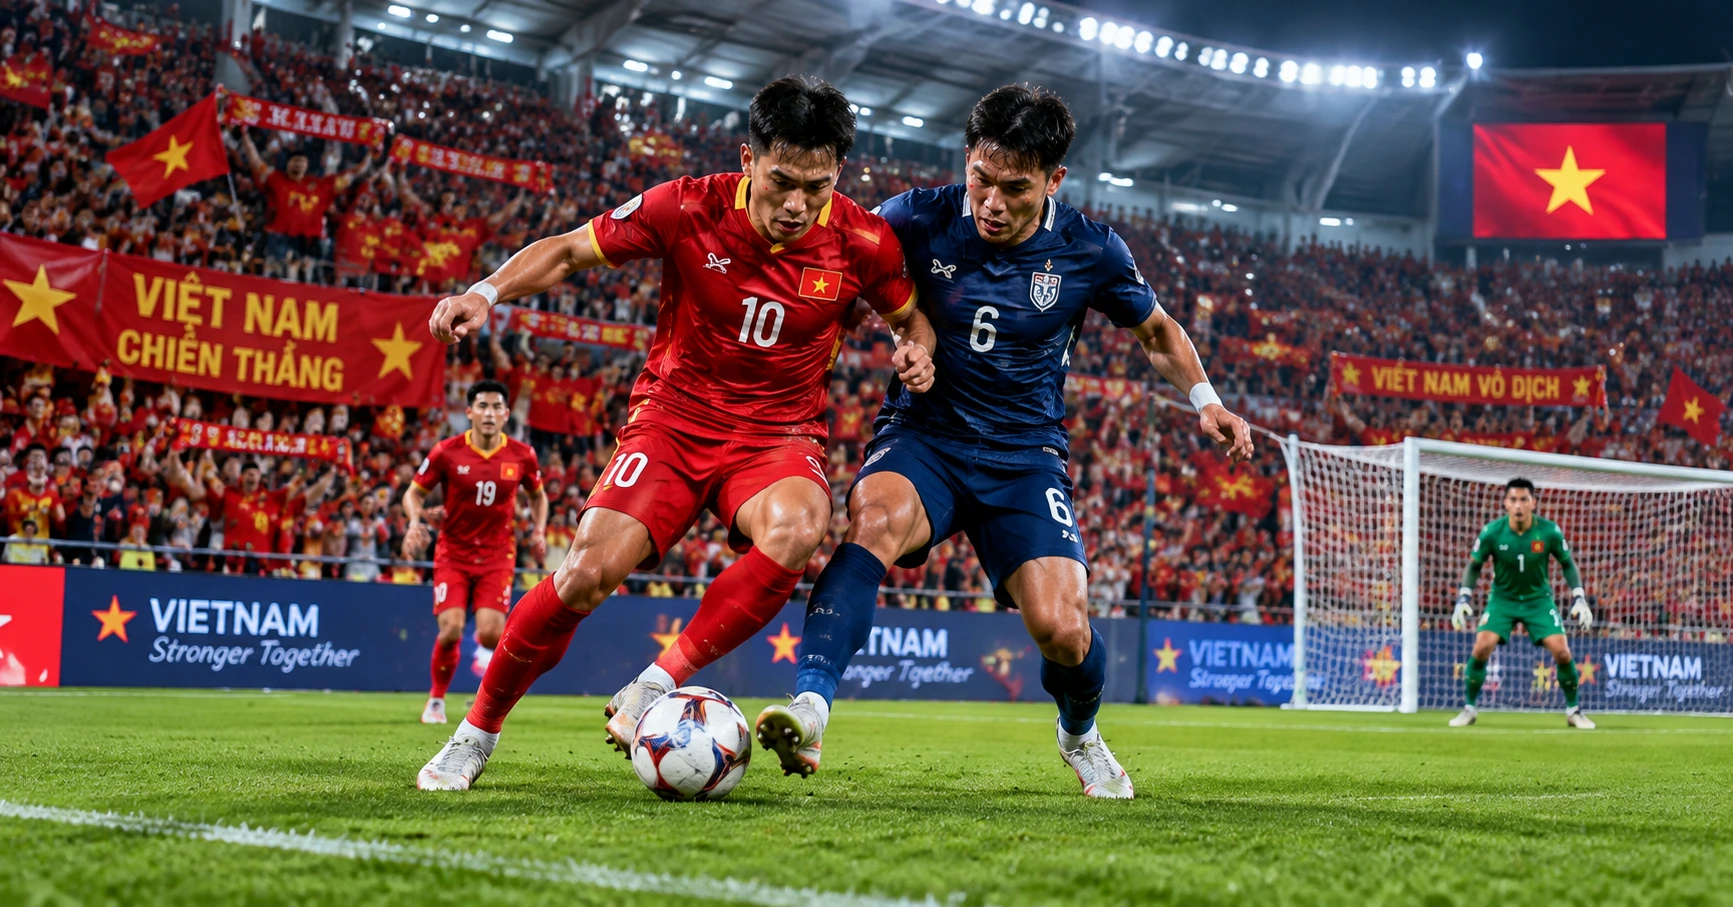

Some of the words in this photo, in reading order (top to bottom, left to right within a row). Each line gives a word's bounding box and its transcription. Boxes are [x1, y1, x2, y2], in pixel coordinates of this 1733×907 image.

[243, 292, 339, 344] NAM
[738, 296, 785, 348] 10
[969, 305, 1000, 353] 6
[1423, 370, 1471, 398] NAM
[603, 452, 649, 489] 10
[475, 480, 497, 507] 19
[1044, 487, 1074, 528] 6
[1516, 553, 1525, 574] 1
[149, 597, 319, 638] VIETNAM
[149, 635, 255, 672] Stronger
[259, 639, 361, 674] Together
[855, 625, 949, 659] TNAM
[1188, 638, 1295, 669] VIETNAM
[1604, 652, 1702, 680] VIETNAM
